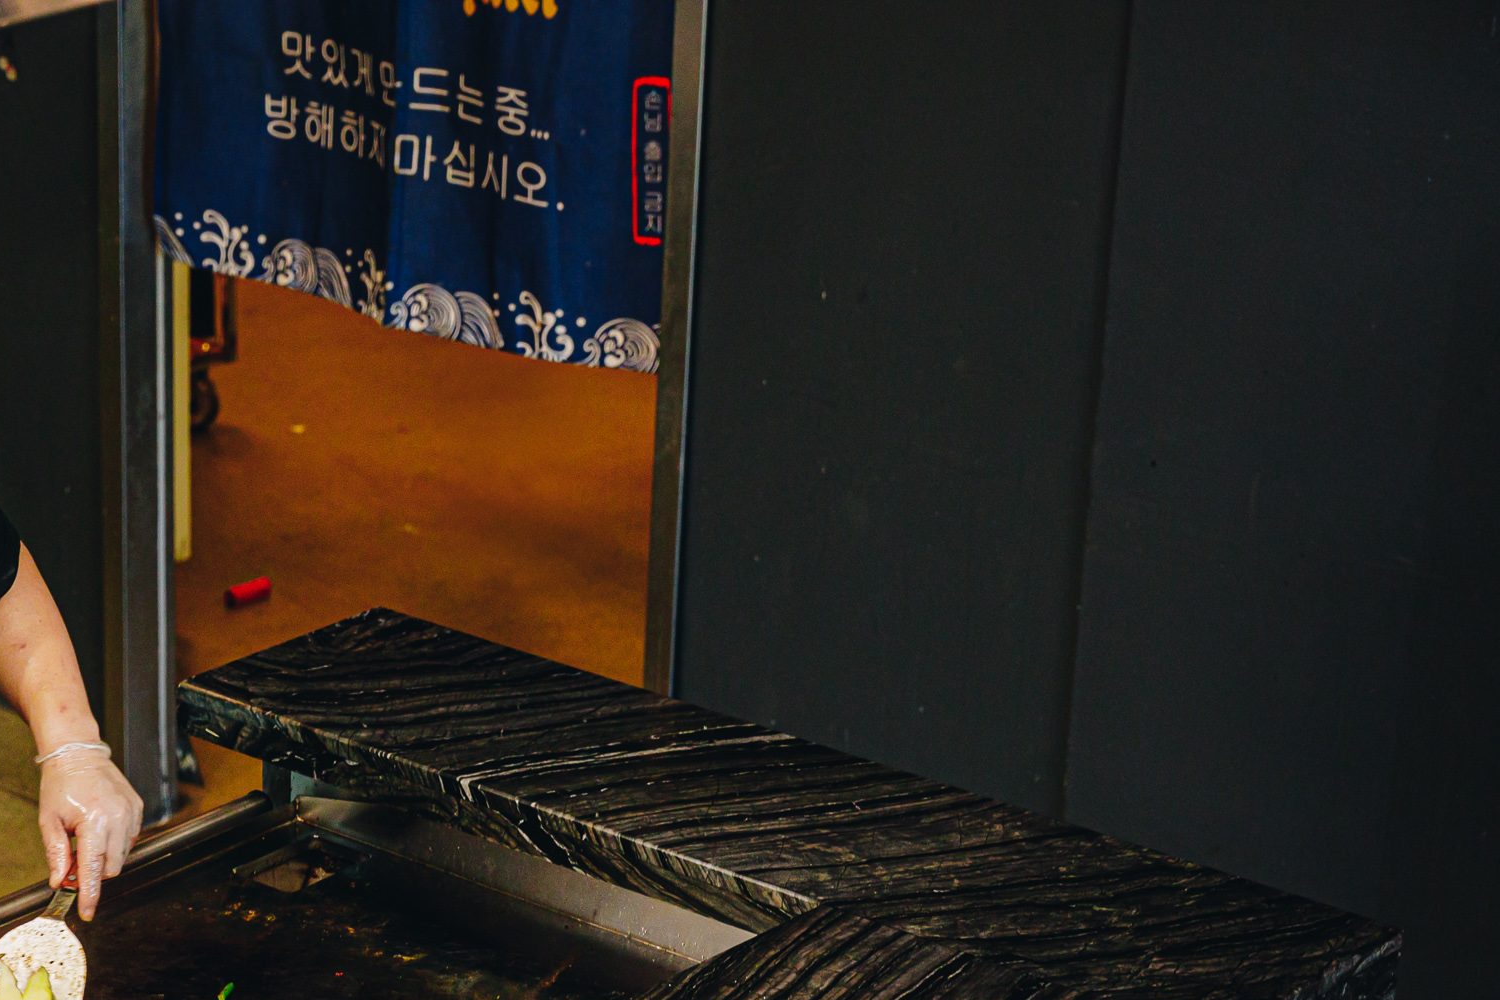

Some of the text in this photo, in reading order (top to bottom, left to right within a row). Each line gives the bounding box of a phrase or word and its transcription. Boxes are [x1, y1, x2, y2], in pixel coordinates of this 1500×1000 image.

[281, 30, 375, 96] 맛있게
[378, 60, 486, 125] 만드는
[264, 93, 388, 170] 방해하지
